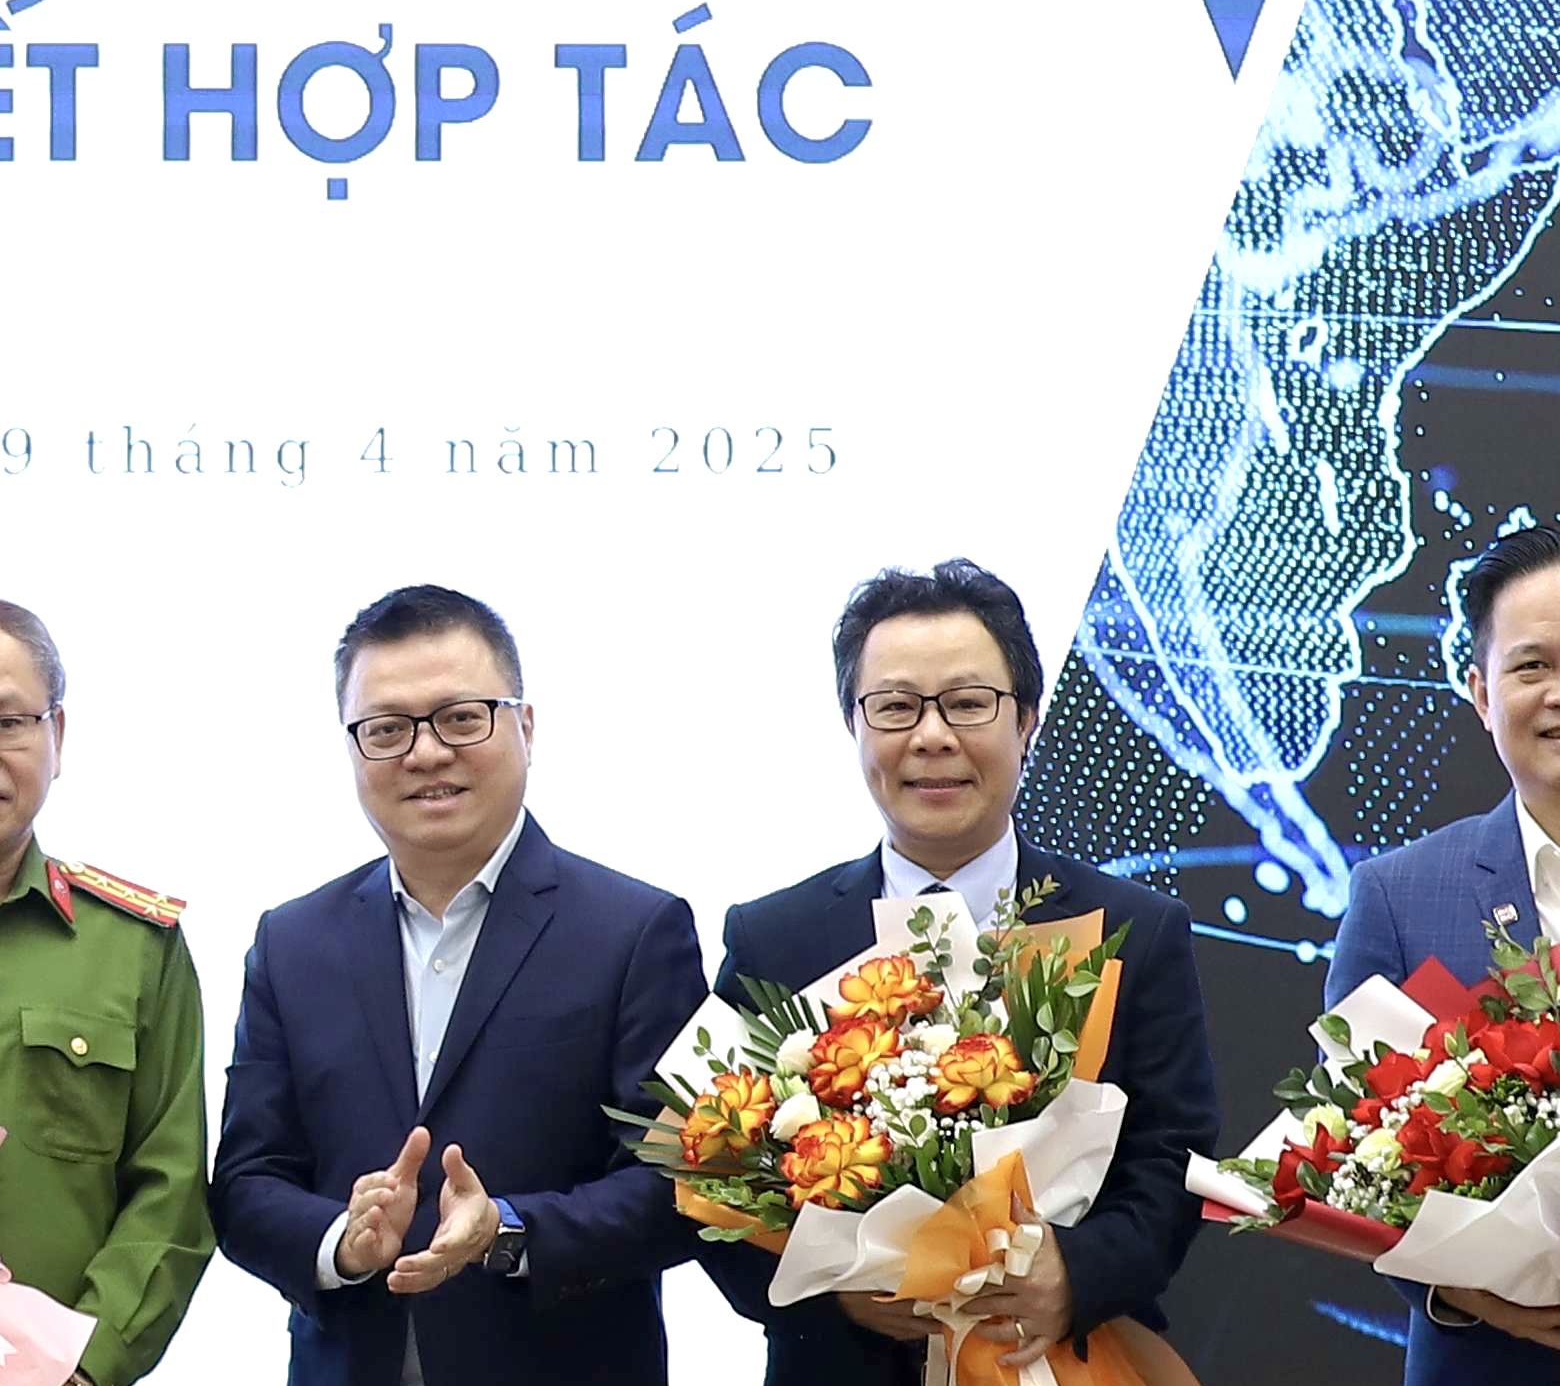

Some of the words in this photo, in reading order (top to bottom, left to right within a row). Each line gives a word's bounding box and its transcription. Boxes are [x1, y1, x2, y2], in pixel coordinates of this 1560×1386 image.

[160, 21, 503, 203] HỢP
[552, 0, 875, 165] TÁC
[1, 426, 33, 476] 9
[84, 422, 311, 489] tháng
[359, 426, 394, 474] 4
[444, 425, 600, 475] năm
[650, 425, 838, 475] 2025
